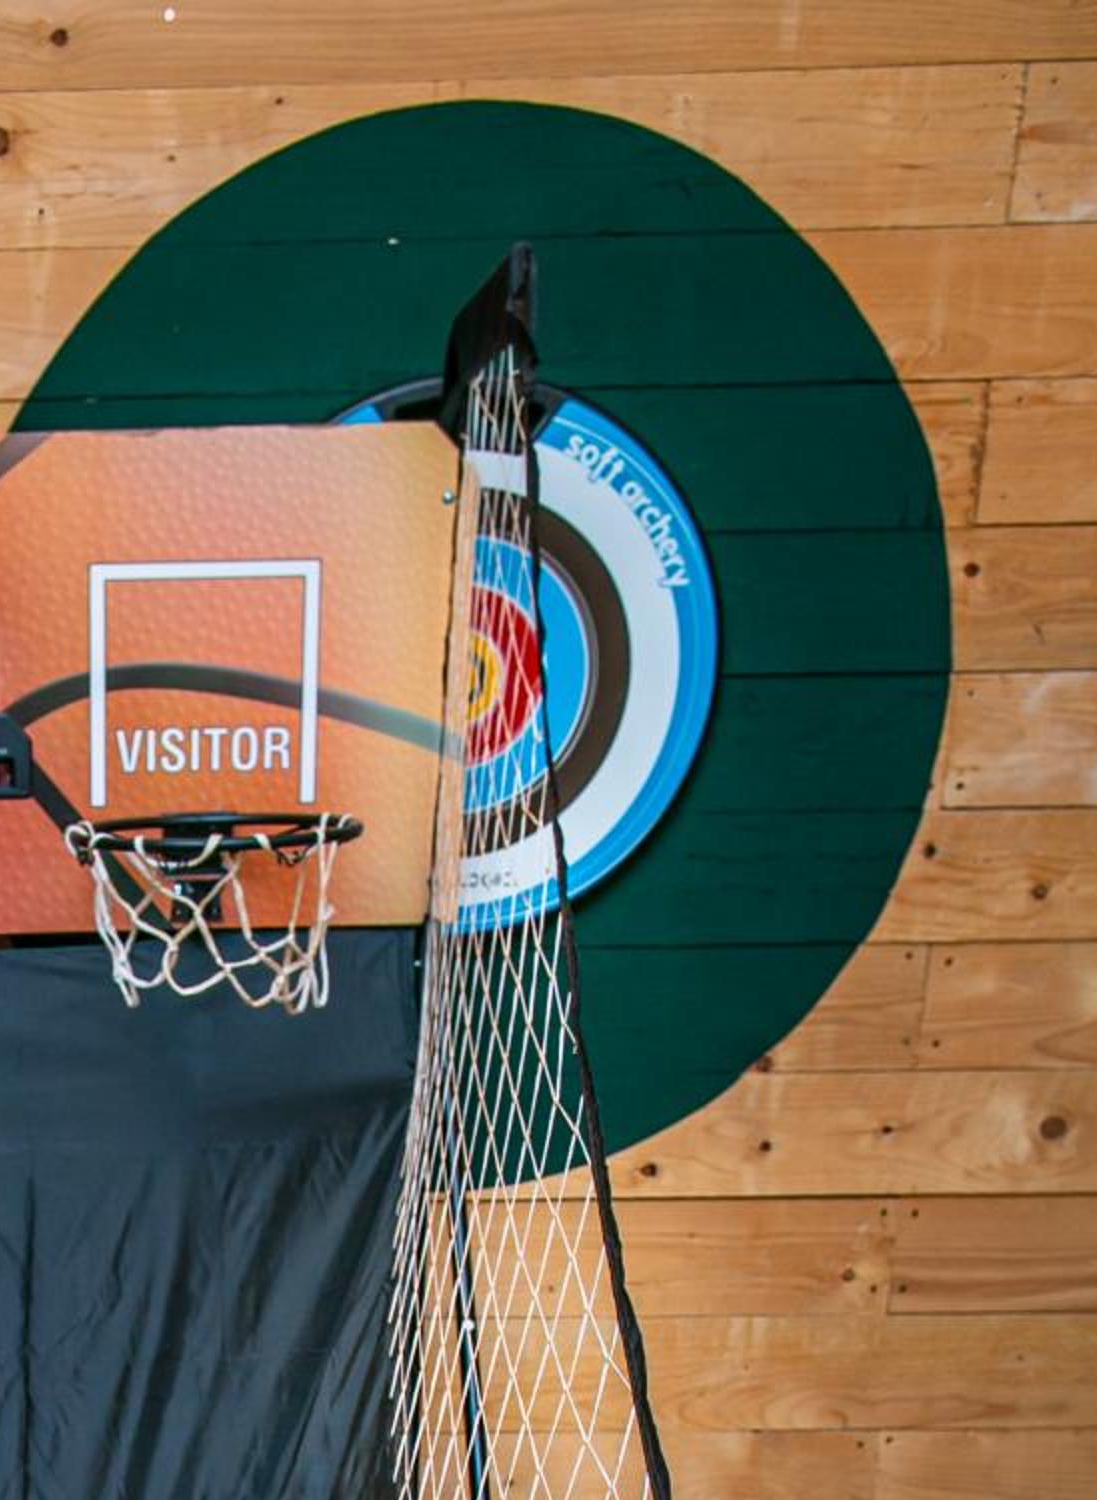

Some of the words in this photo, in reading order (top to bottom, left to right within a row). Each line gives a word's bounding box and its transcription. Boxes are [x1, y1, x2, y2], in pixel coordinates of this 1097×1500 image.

[567, 434, 625, 484] soft
[621, 480, 690, 587] archery
[115, 726, 291, 773] VISITOR
